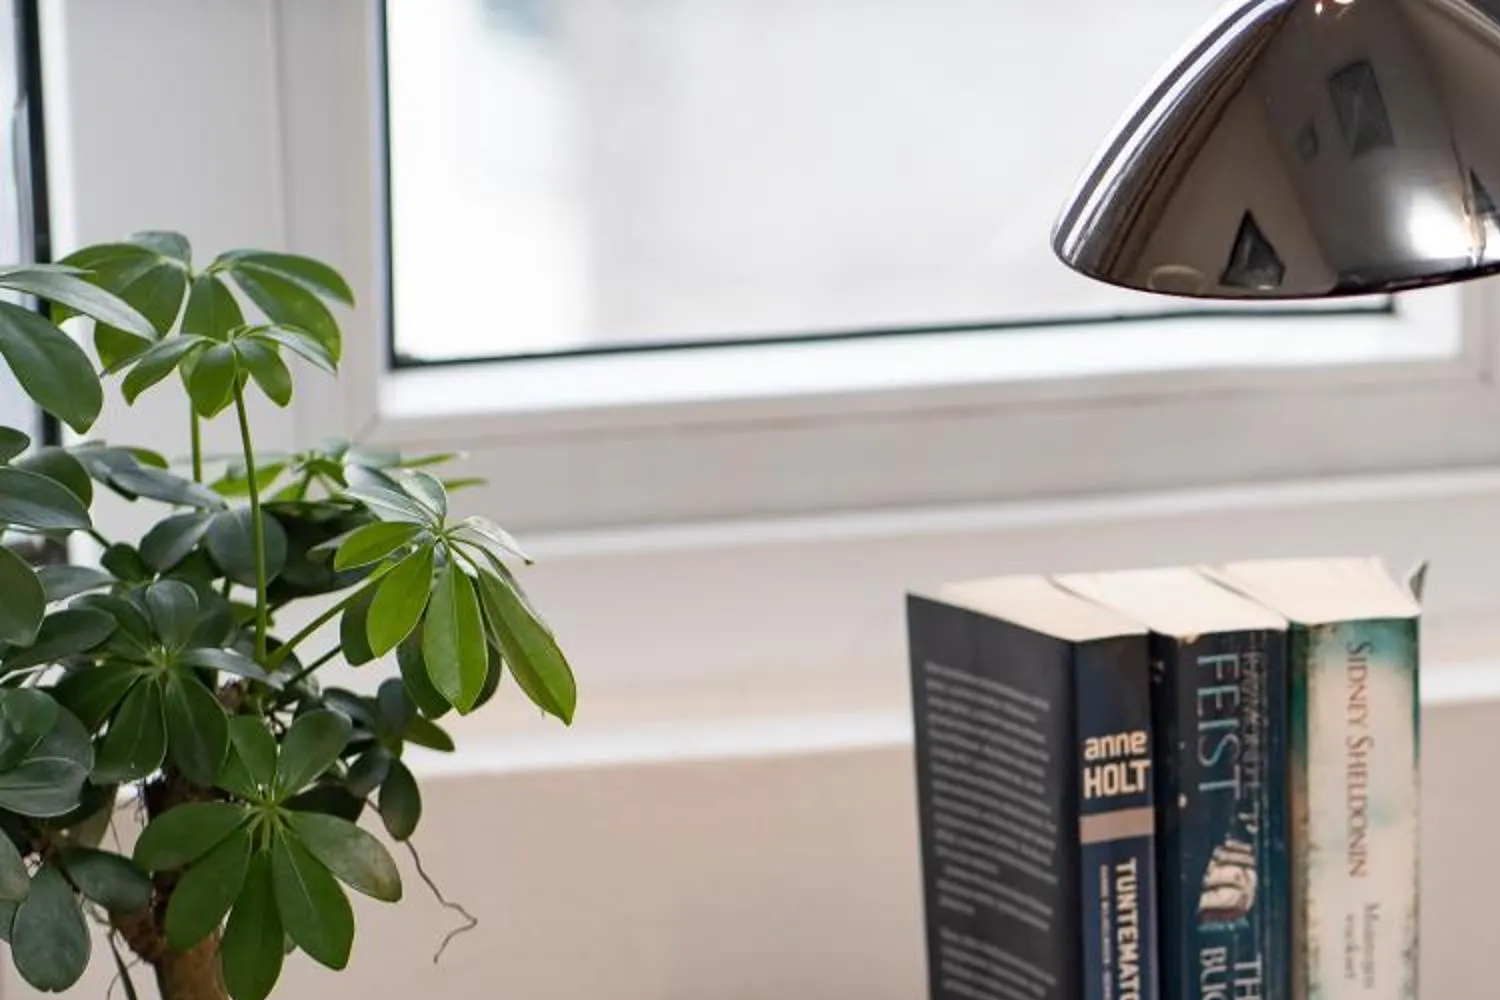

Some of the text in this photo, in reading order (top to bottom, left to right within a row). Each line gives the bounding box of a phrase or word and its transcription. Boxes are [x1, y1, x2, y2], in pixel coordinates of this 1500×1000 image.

[1197, 653, 1241, 800] FEIST
[1346, 640, 1375, 728] SIDNEY
[1082, 759, 1152, 799] HOLT
[1083, 730, 1148, 760] anne
[1345, 734, 1375, 878] SHELDONIN
